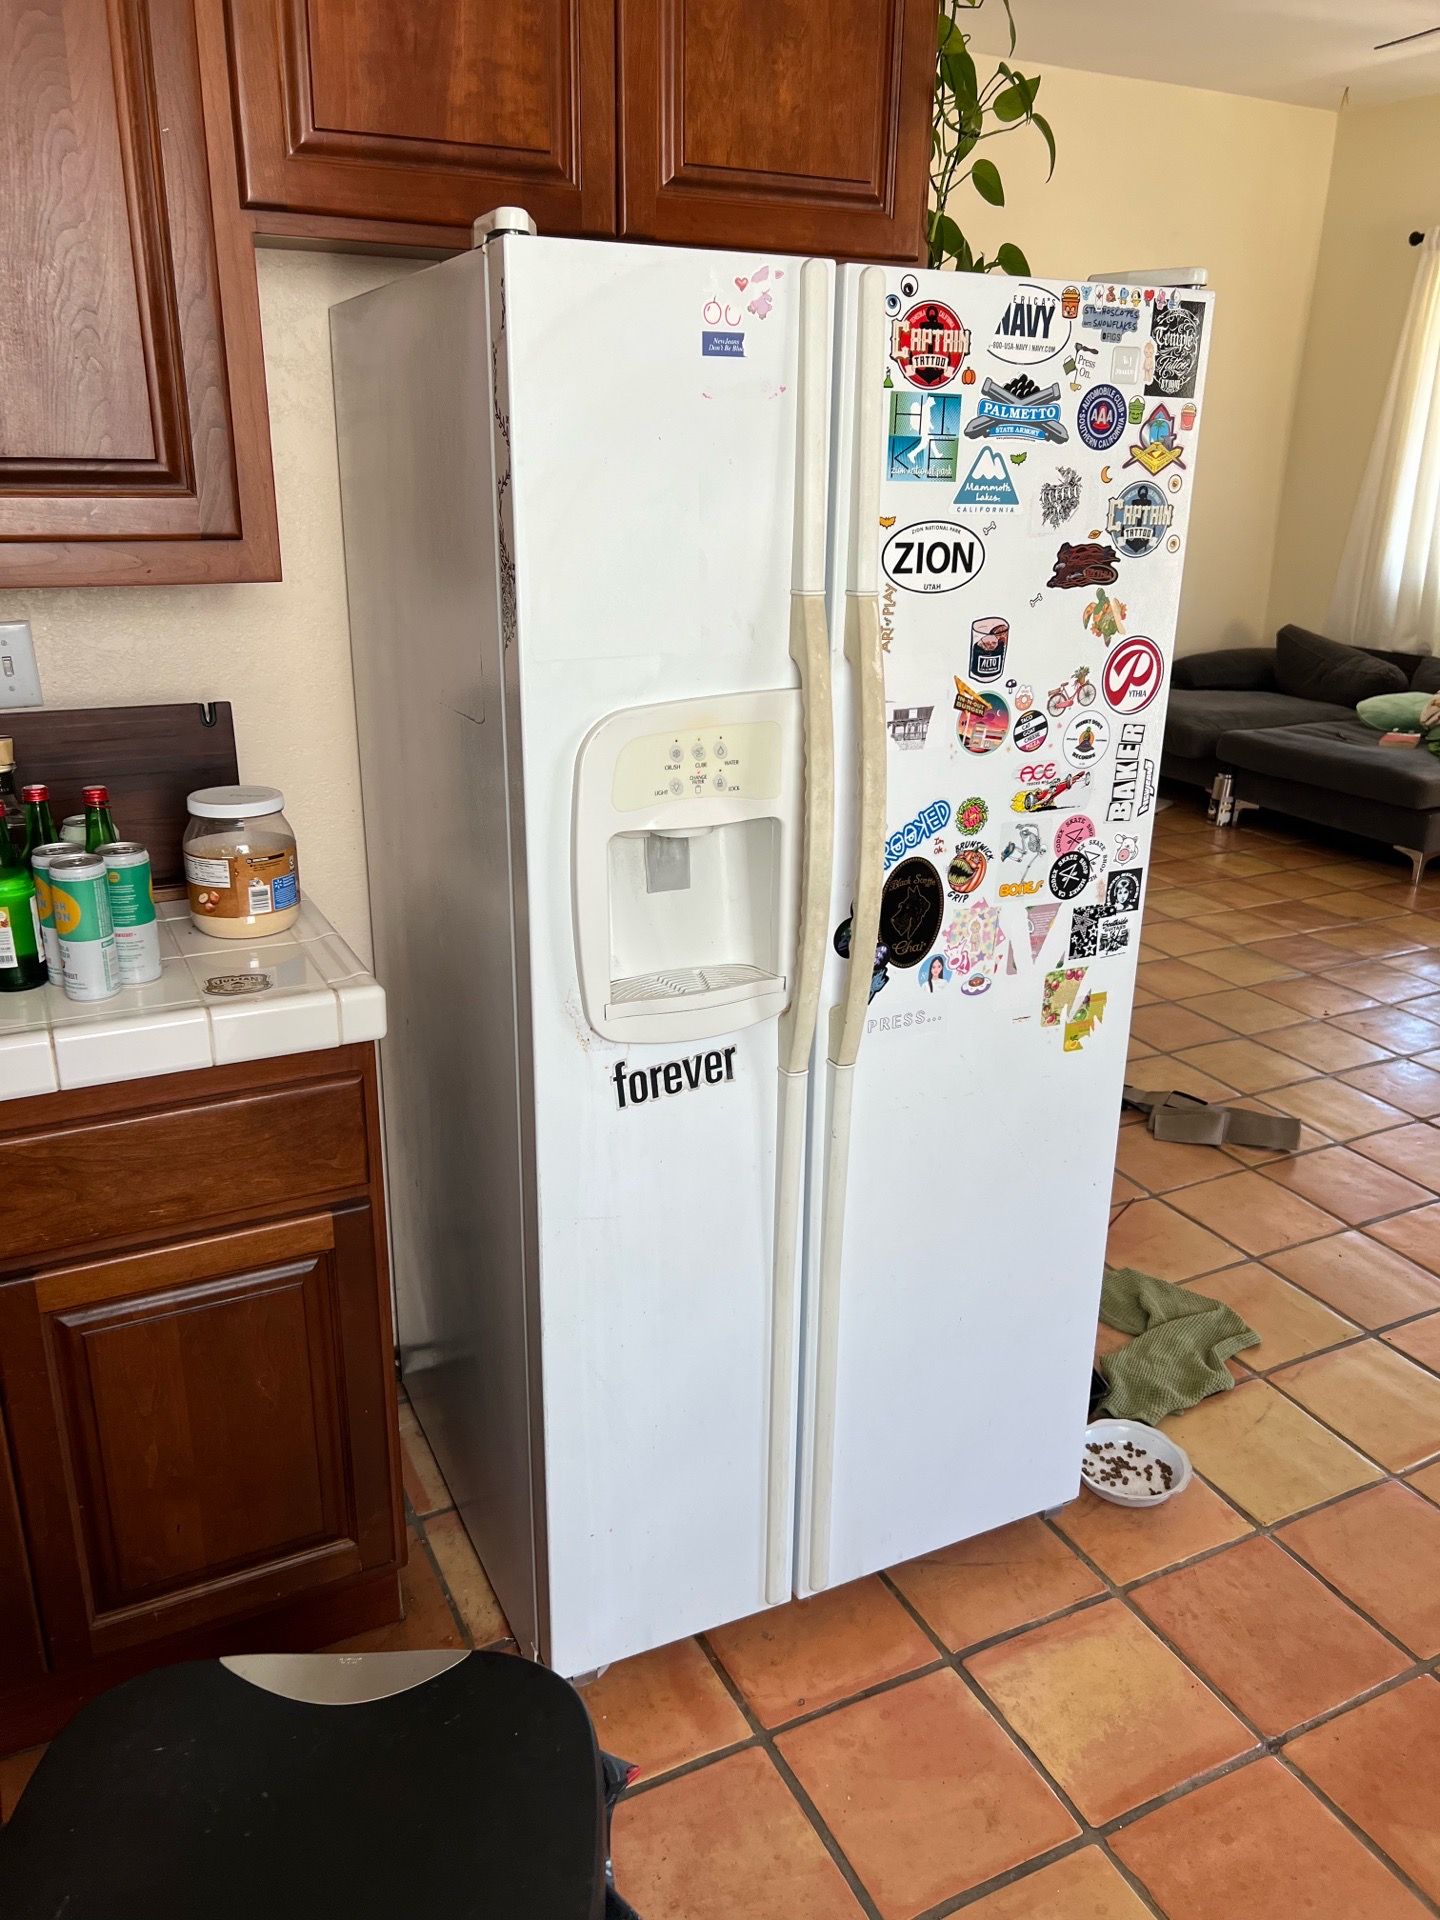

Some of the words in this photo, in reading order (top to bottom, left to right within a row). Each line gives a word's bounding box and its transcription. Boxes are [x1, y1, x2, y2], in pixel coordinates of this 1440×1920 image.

[995, 302, 1055, 338] NAVY
[892, 319, 971, 359] CAPTAIN
[1106, 332, 1120, 340] FIGS
[988, 341, 1028, 352] -800-USA-NAVY
[1030, 344, 1056, 352] NAVY.COM
[914, 356, 946, 367] TATTOO
[1078, 355, 1096, 368] Press
[1082, 387, 1116, 411] AUTOMOBILE
[1114, 394, 1125, 413] CLUB
[983, 402, 1056, 420] PALMETTO
[1090, 406, 1113, 424] AAA
[996, 426, 1014, 434] STATE
[1014, 426, 1040, 437] ARMORY
[1078, 414, 1098, 448] SOUTHERN
[1098, 417, 1125, 448] CALIFORNIA
[964, 482, 1012, 492] Mammoth
[975, 493, 1001, 502] Lakes
[956, 506, 1015, 514] CALIFORNIA
[1106, 498, 1174, 532] CAPTAIN
[912, 527, 924, 535] ZION
[950, 527, 962, 535] PARK
[1126, 528, 1152, 538] TATTOO
[892, 541, 975, 574] ZION
[923, 583, 942, 591] UTAH
[882, 582, 898, 616] PLAY
[880, 626, 894, 654] ART
[981, 658, 997, 668] ALTO
[956, 701, 984, 714] BURGER
[957, 695, 985, 710] IN-N-OUT
[1020, 714, 1034, 724] TACO
[1022, 722, 1031, 730] CAT
[1025, 740, 1041, 750] PIZZA
[1072, 752, 1096, 760] RECORDS
[1020, 762, 1056, 782] ACE
[1106, 724, 1146, 821] BAKER
[884, 800, 950, 870] ROOKED
[1056, 829, 1064, 853] CODEX
[1066, 817, 1086, 828] SKATE
[954, 840, 994, 861] BRUNSWICK
[1089, 840, 1106, 852] SKATE
[1100, 854, 1108, 873] SHOP
[1058, 854, 1079, 867] SKATE
[1078, 858, 1088, 874] SHOP
[1050, 868, 1058, 892] CODEX
[1069, 878, 1086, 897] HEMET
[998, 880, 1045, 898] BONES
[1058, 890, 1066, 898] CA
[947, 890, 969, 904] GRIP
[892, 940, 927, 956] Chai
[214, 976, 259, 985] JULIAN
[612, 1046, 737, 1108] forever
